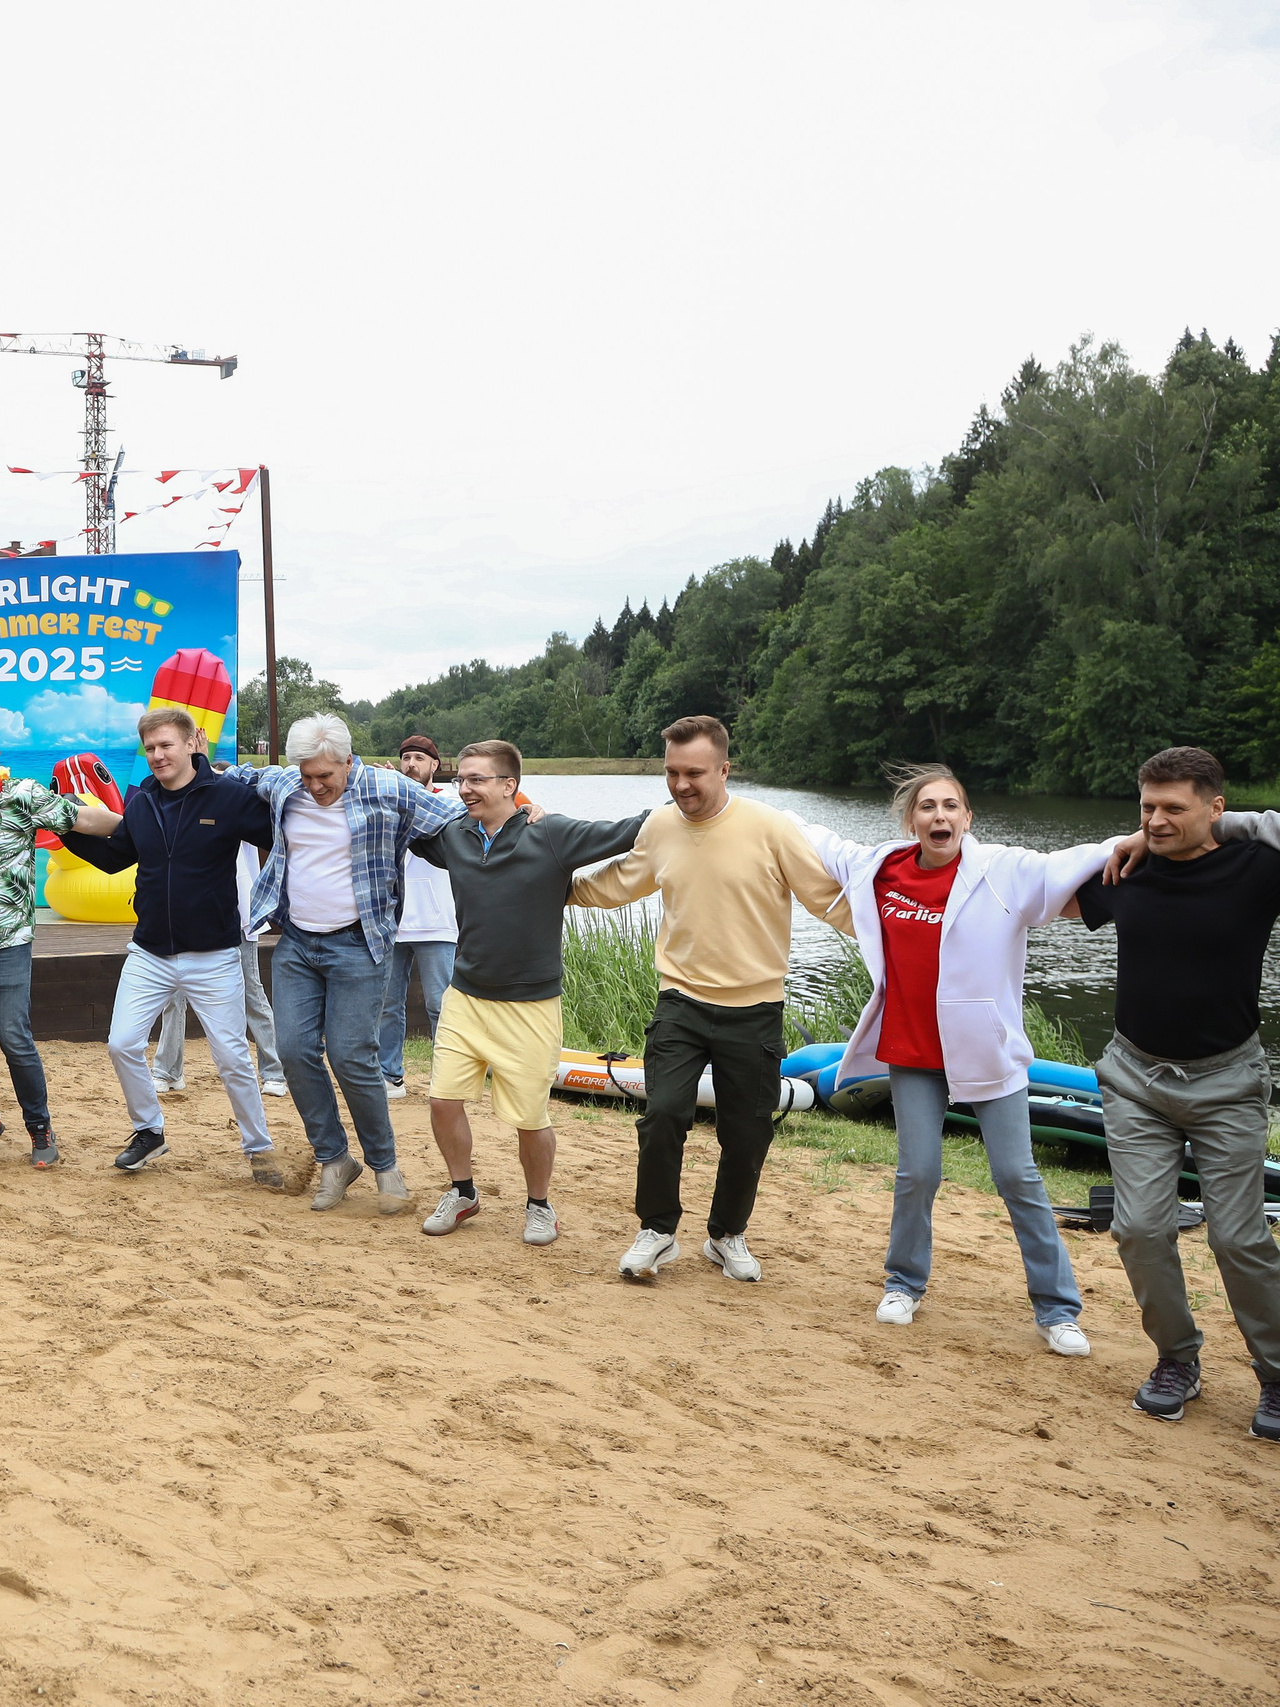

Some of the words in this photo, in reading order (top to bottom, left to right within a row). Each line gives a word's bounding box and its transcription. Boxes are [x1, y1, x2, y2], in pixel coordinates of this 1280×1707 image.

[87, 614, 163, 645] FEST
[896, 909, 943, 924] arlig
[567, 1074, 645, 1090] HYDRO-FORC
